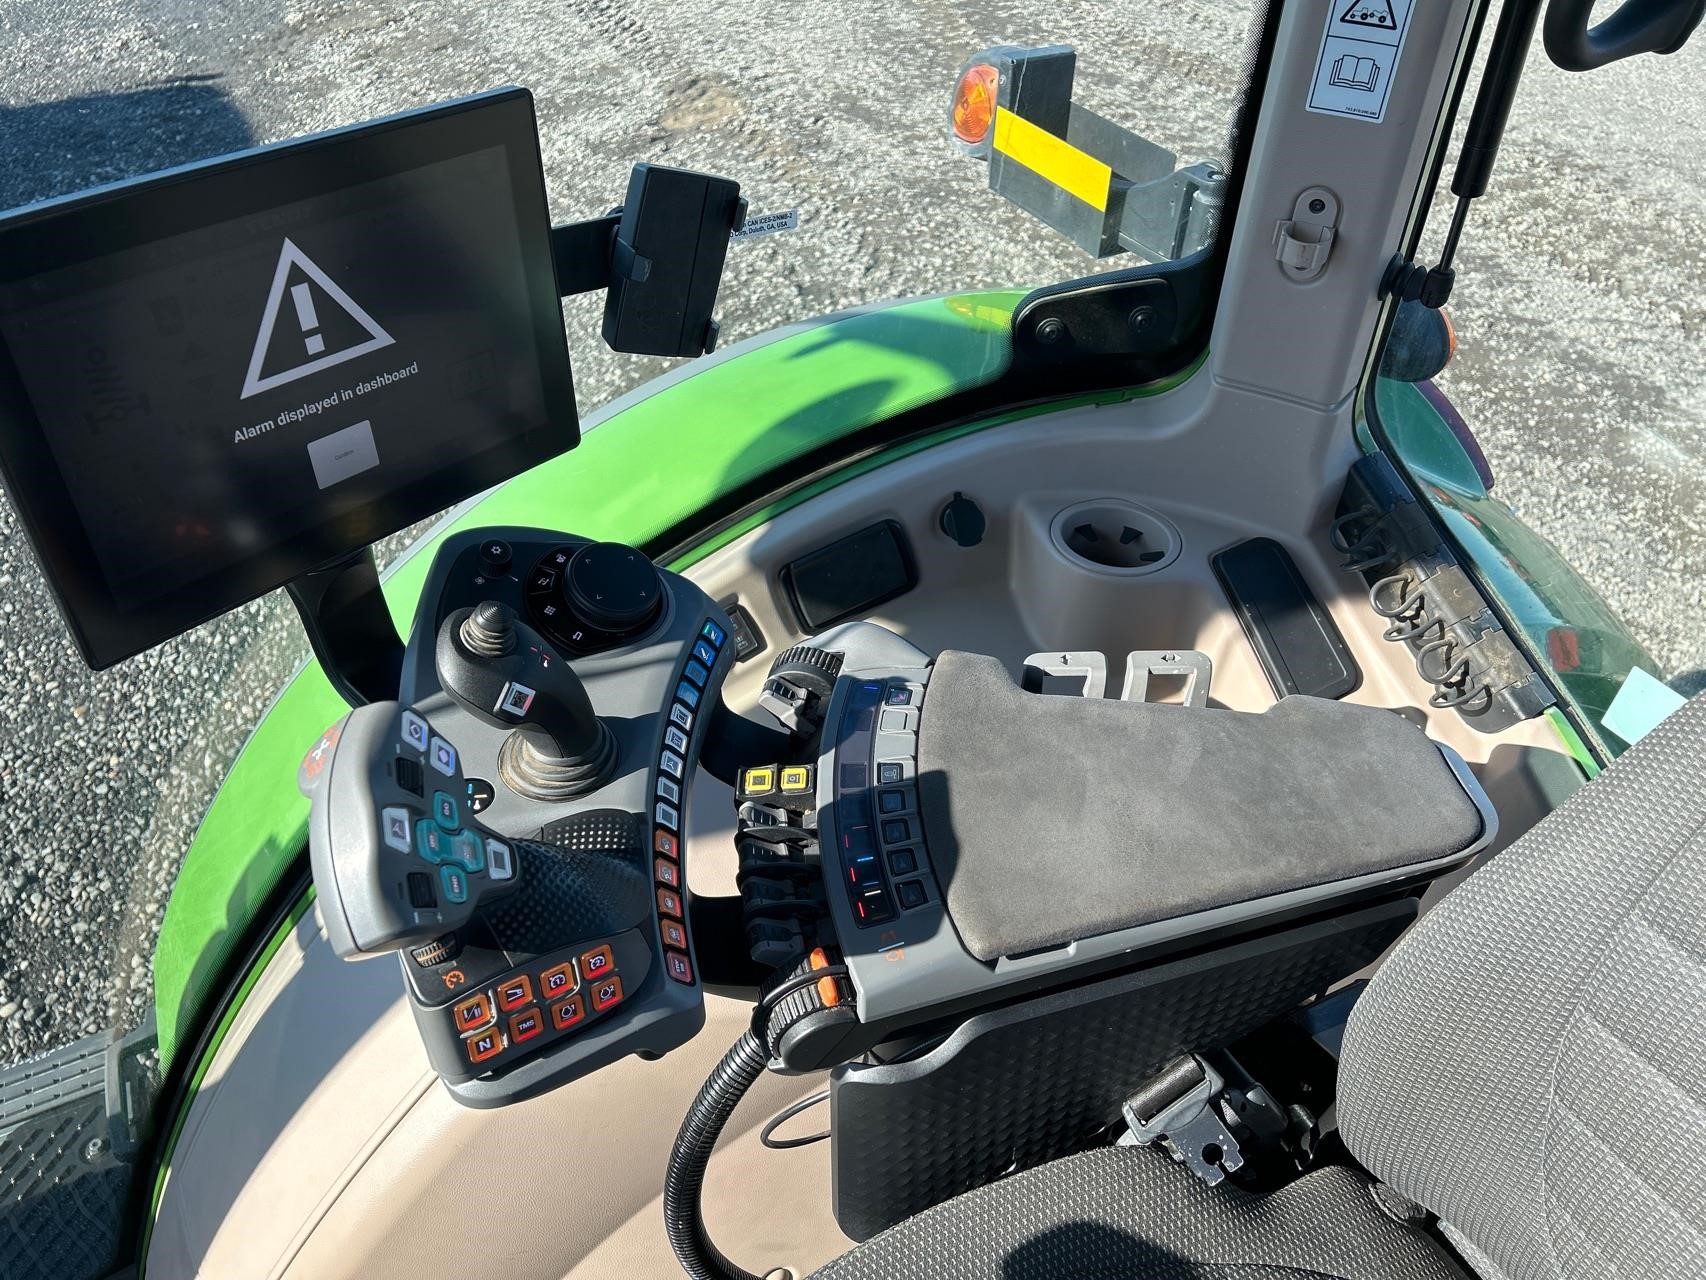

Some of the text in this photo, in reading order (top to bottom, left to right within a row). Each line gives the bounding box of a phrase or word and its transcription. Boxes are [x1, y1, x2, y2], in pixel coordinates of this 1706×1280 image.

[748, 219, 759, 227] CAN
[233, 361, 419, 444] Alarm displayed in dashboard
[519, 1020, 535, 1031] TMS
[478, 1037, 492, 1052] N
